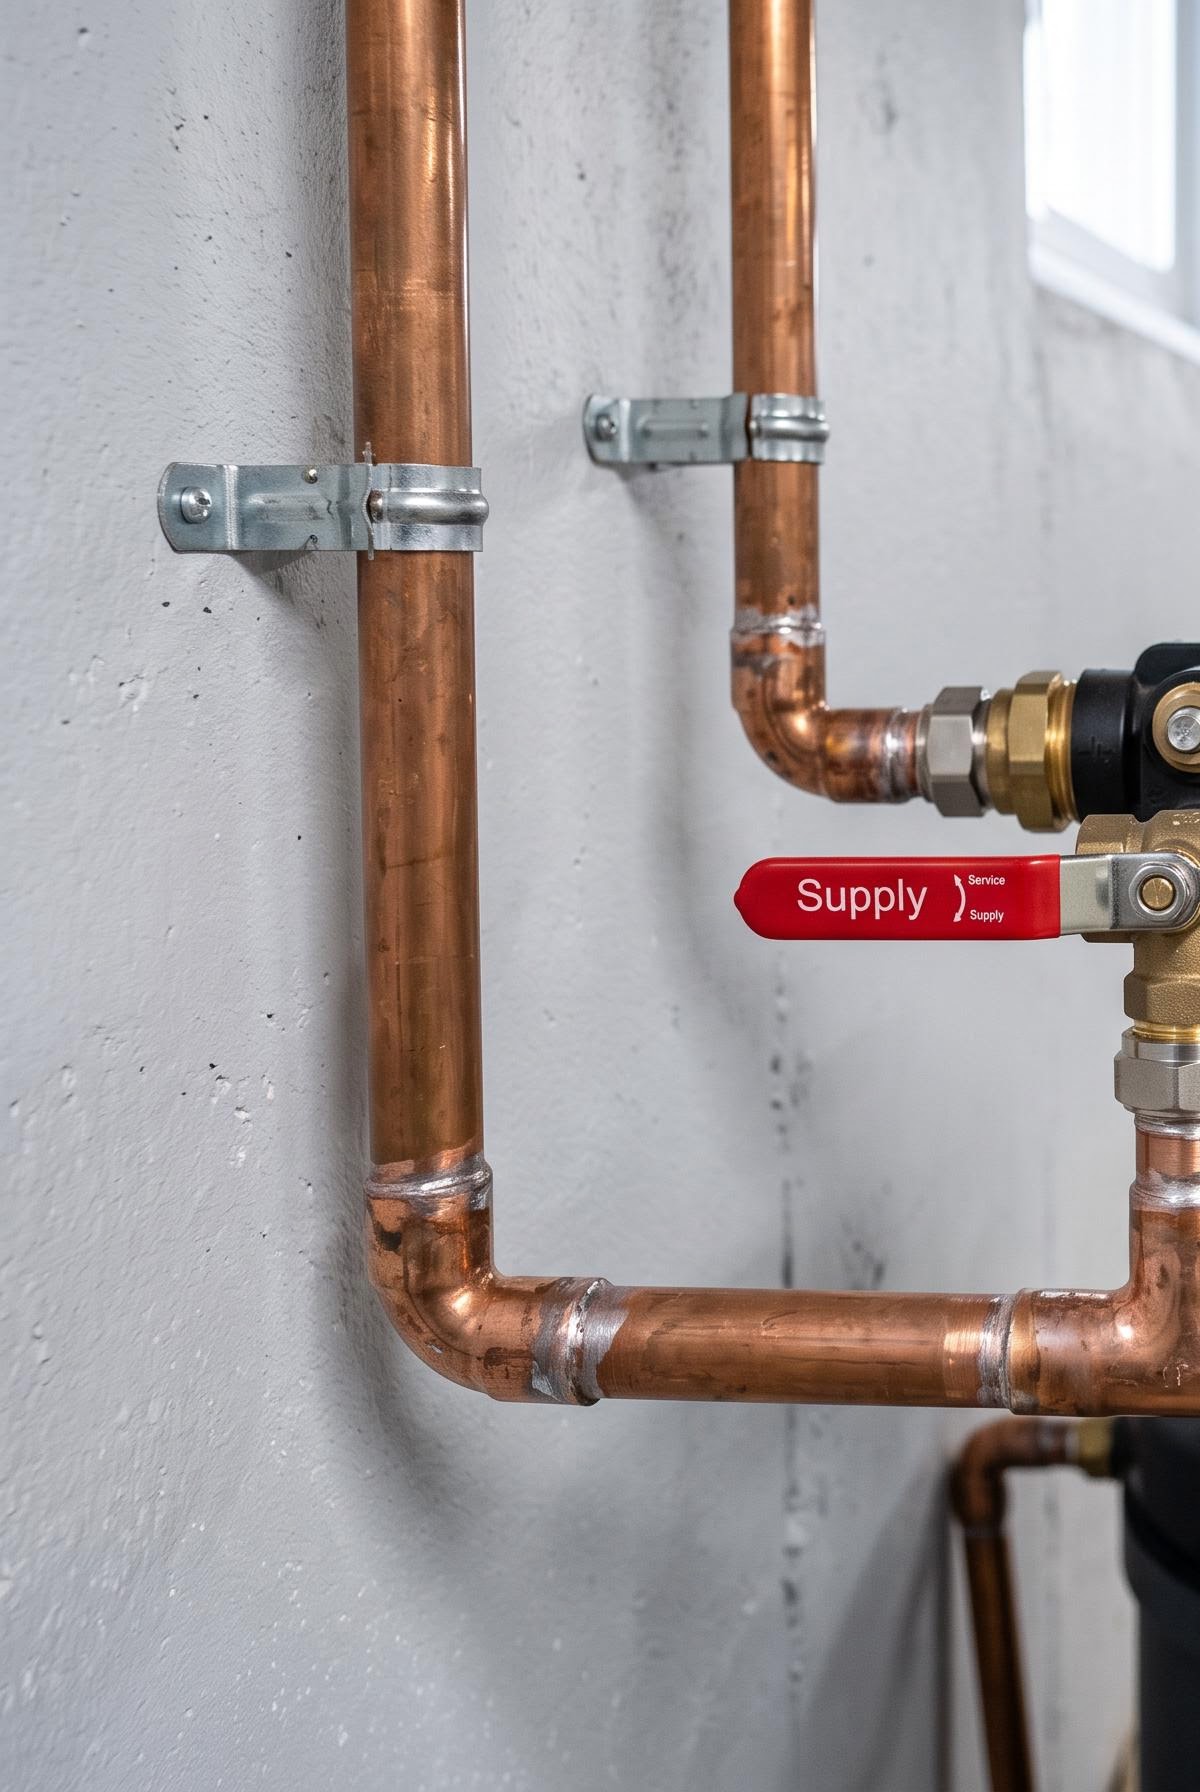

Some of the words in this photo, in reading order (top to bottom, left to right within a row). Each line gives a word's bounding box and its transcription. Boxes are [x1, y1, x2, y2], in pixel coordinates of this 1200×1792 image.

[968, 874, 1005, 885] Service
[797, 878, 928, 920] Supply
[970, 909, 1004, 923] Supply
